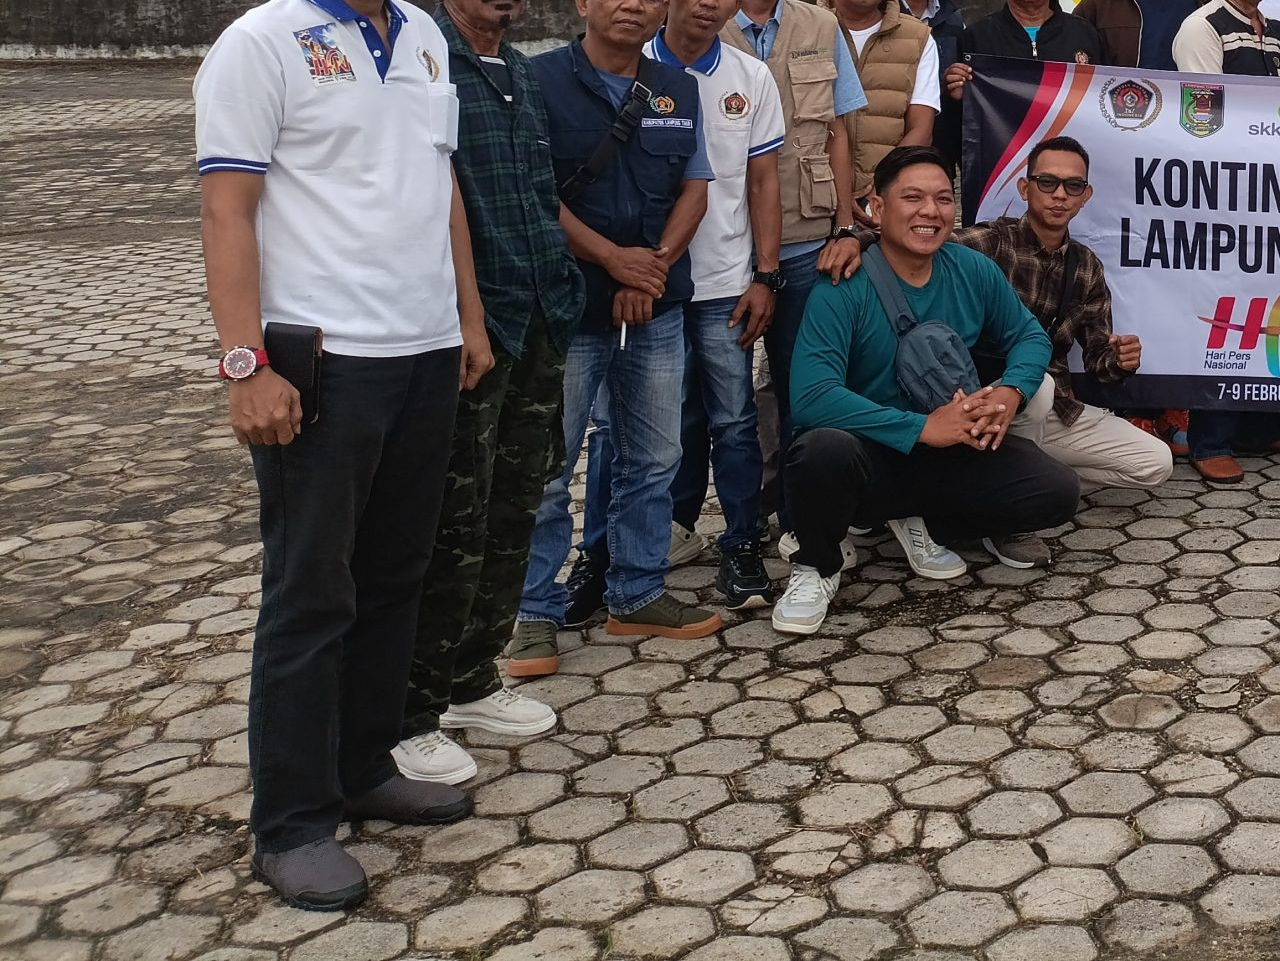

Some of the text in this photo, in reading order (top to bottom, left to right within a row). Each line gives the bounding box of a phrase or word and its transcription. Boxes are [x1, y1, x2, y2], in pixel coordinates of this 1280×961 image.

[1205, 351, 1251, 361] Hari Pers
[1203, 360, 1247, 370] Nasional
[1217, 383, 1240, 400] 7-9
